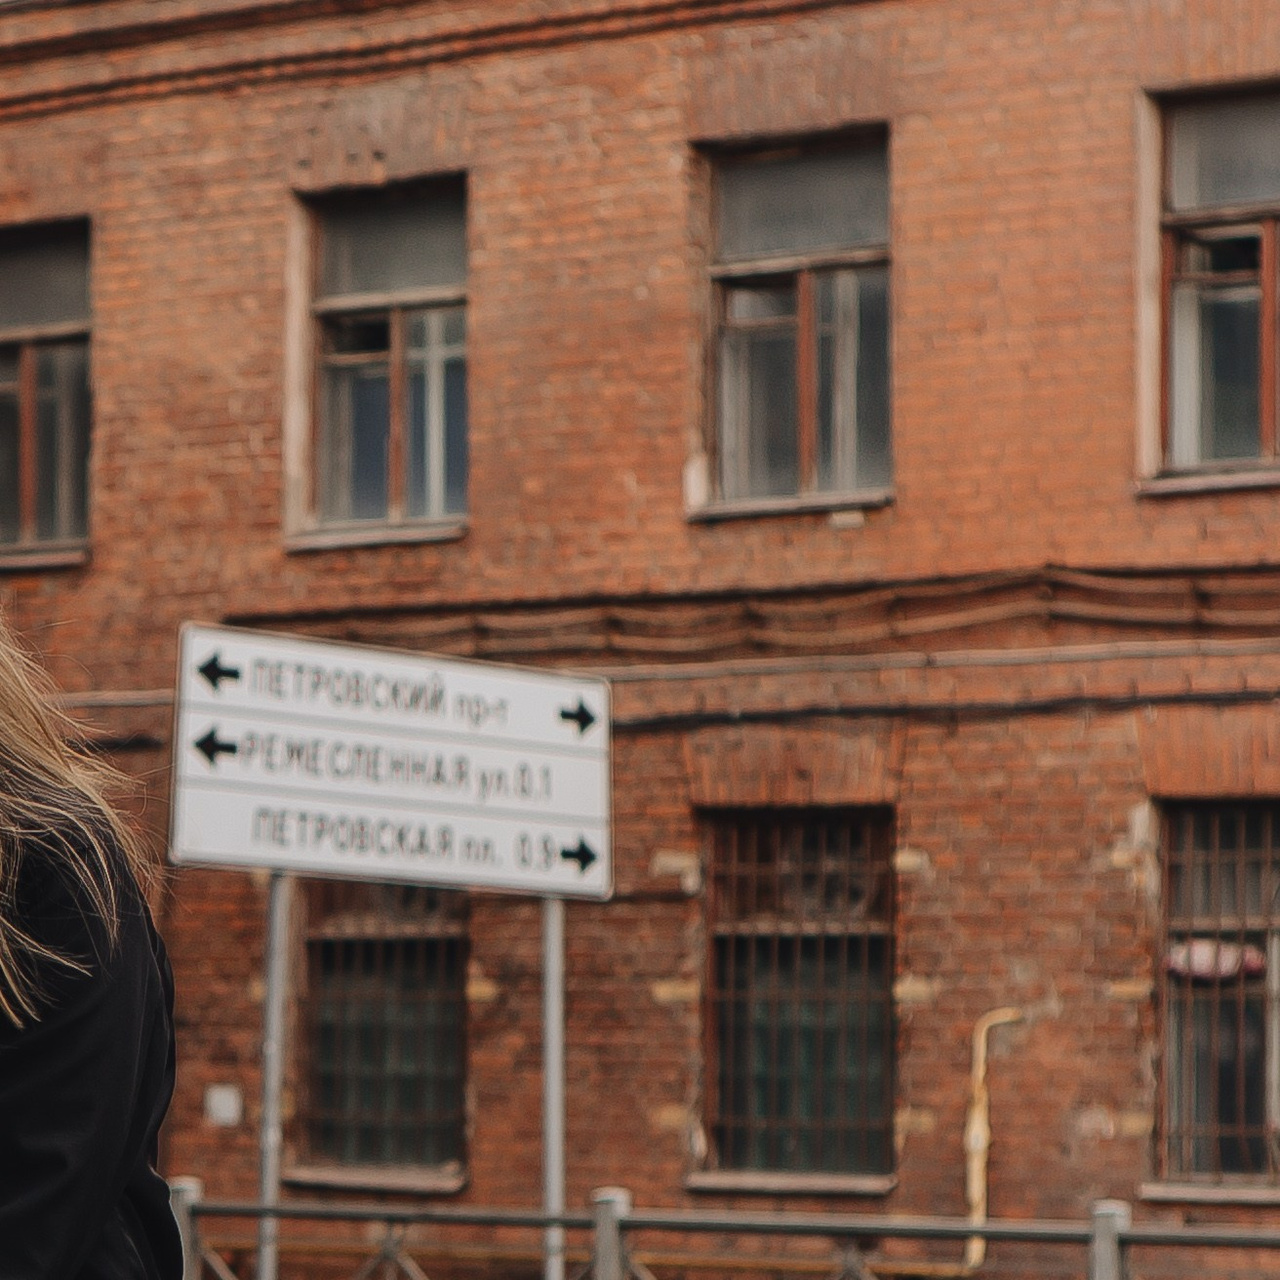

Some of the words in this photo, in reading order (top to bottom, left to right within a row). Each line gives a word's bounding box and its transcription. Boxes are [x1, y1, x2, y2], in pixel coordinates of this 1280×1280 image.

[251, 658, 445, 713] ПЕТРОВСКИЙ
[242, 729, 470, 789] РЕМЕСЛЕННАЯ
[253, 807, 454, 859] ПЕТРОВСКАЯ
